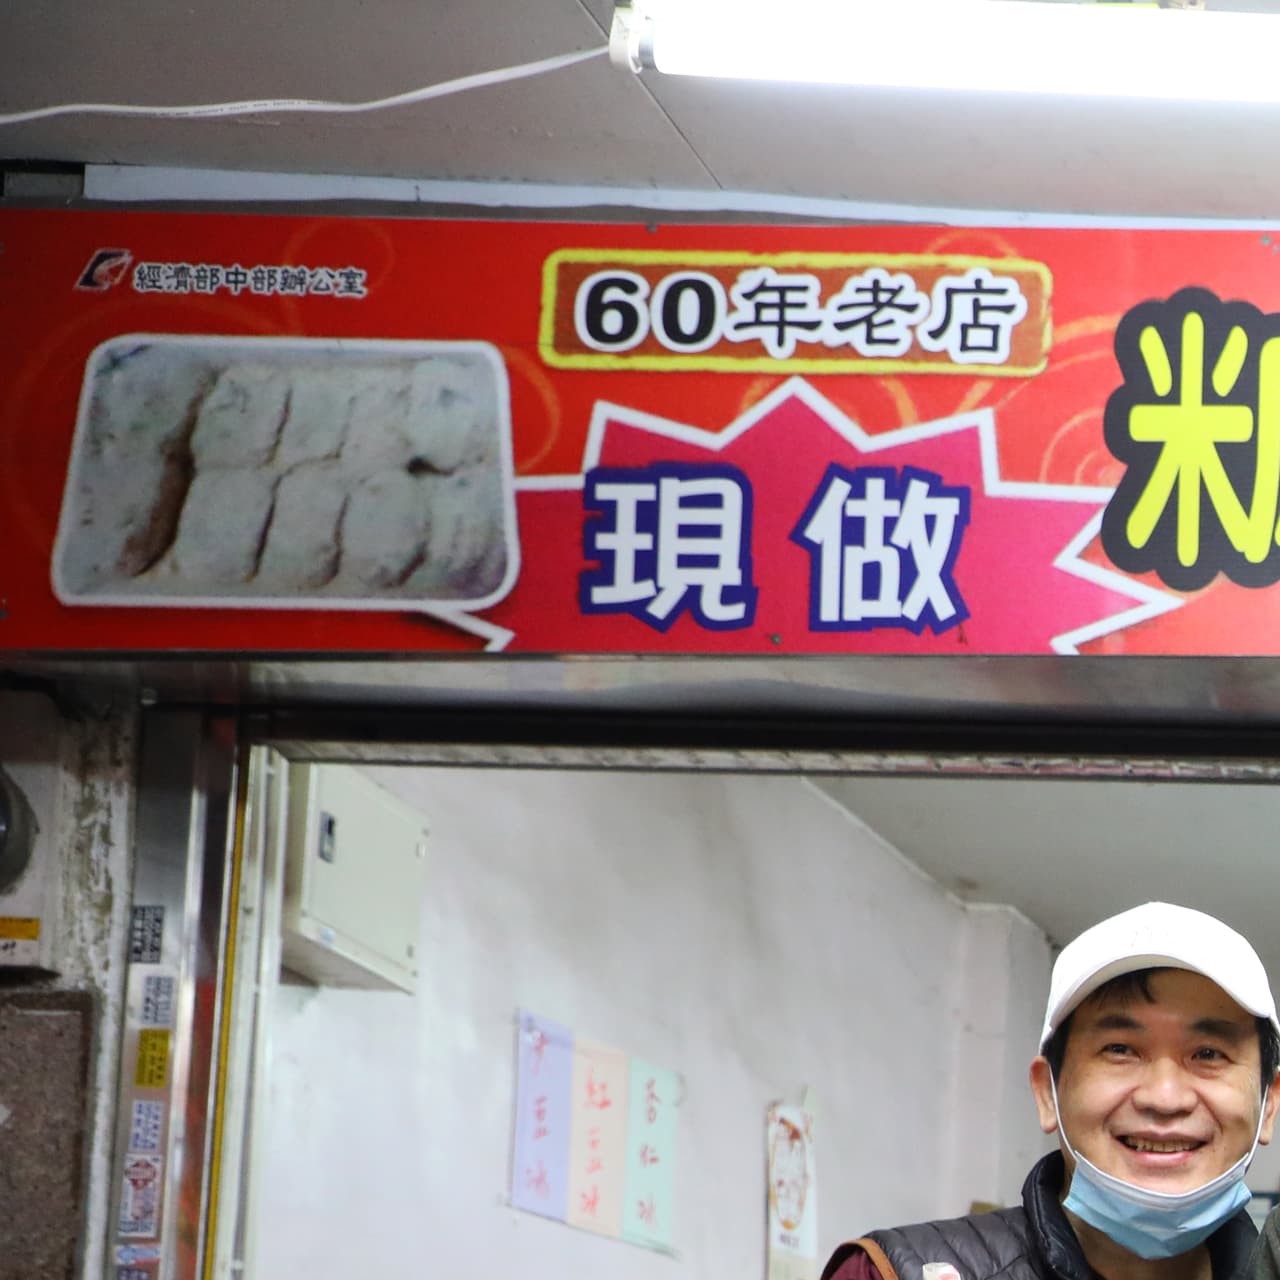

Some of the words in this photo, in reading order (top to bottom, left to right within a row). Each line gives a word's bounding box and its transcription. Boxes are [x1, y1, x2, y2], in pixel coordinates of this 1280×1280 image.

[134, 262, 367, 299] 經濟部中部辦公室
[580, 271, 1024, 361] 60年老店
[586, 468, 968, 632] 現做
